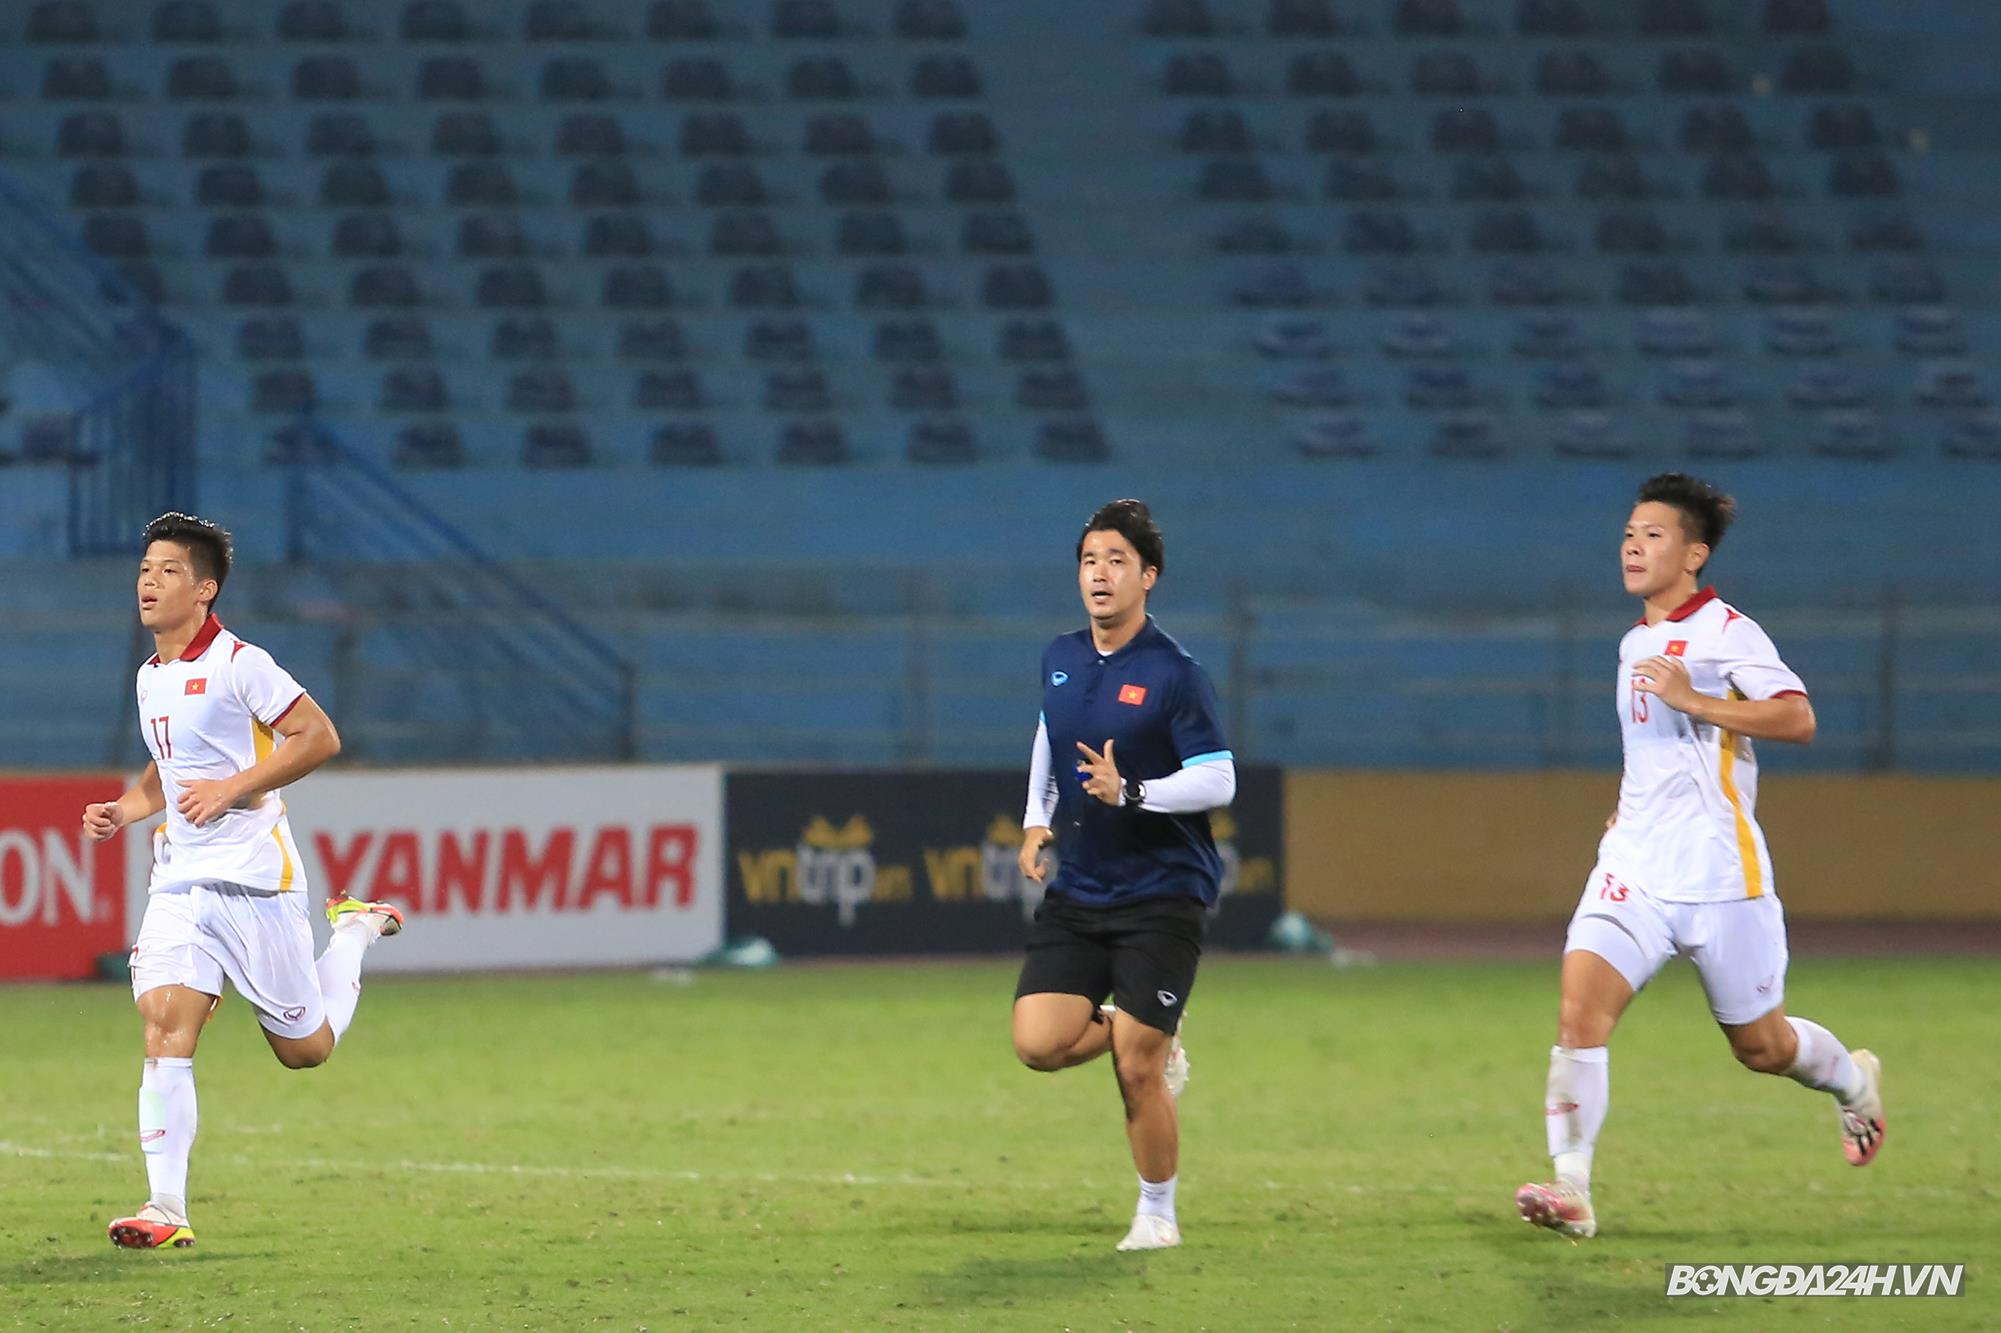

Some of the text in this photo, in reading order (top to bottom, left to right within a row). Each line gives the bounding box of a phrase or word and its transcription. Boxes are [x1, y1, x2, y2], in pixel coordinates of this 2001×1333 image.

[150, 716, 172, 760] 17
[311, 824, 698, 914] YANMAR
[1600, 872, 1630, 901] 13
